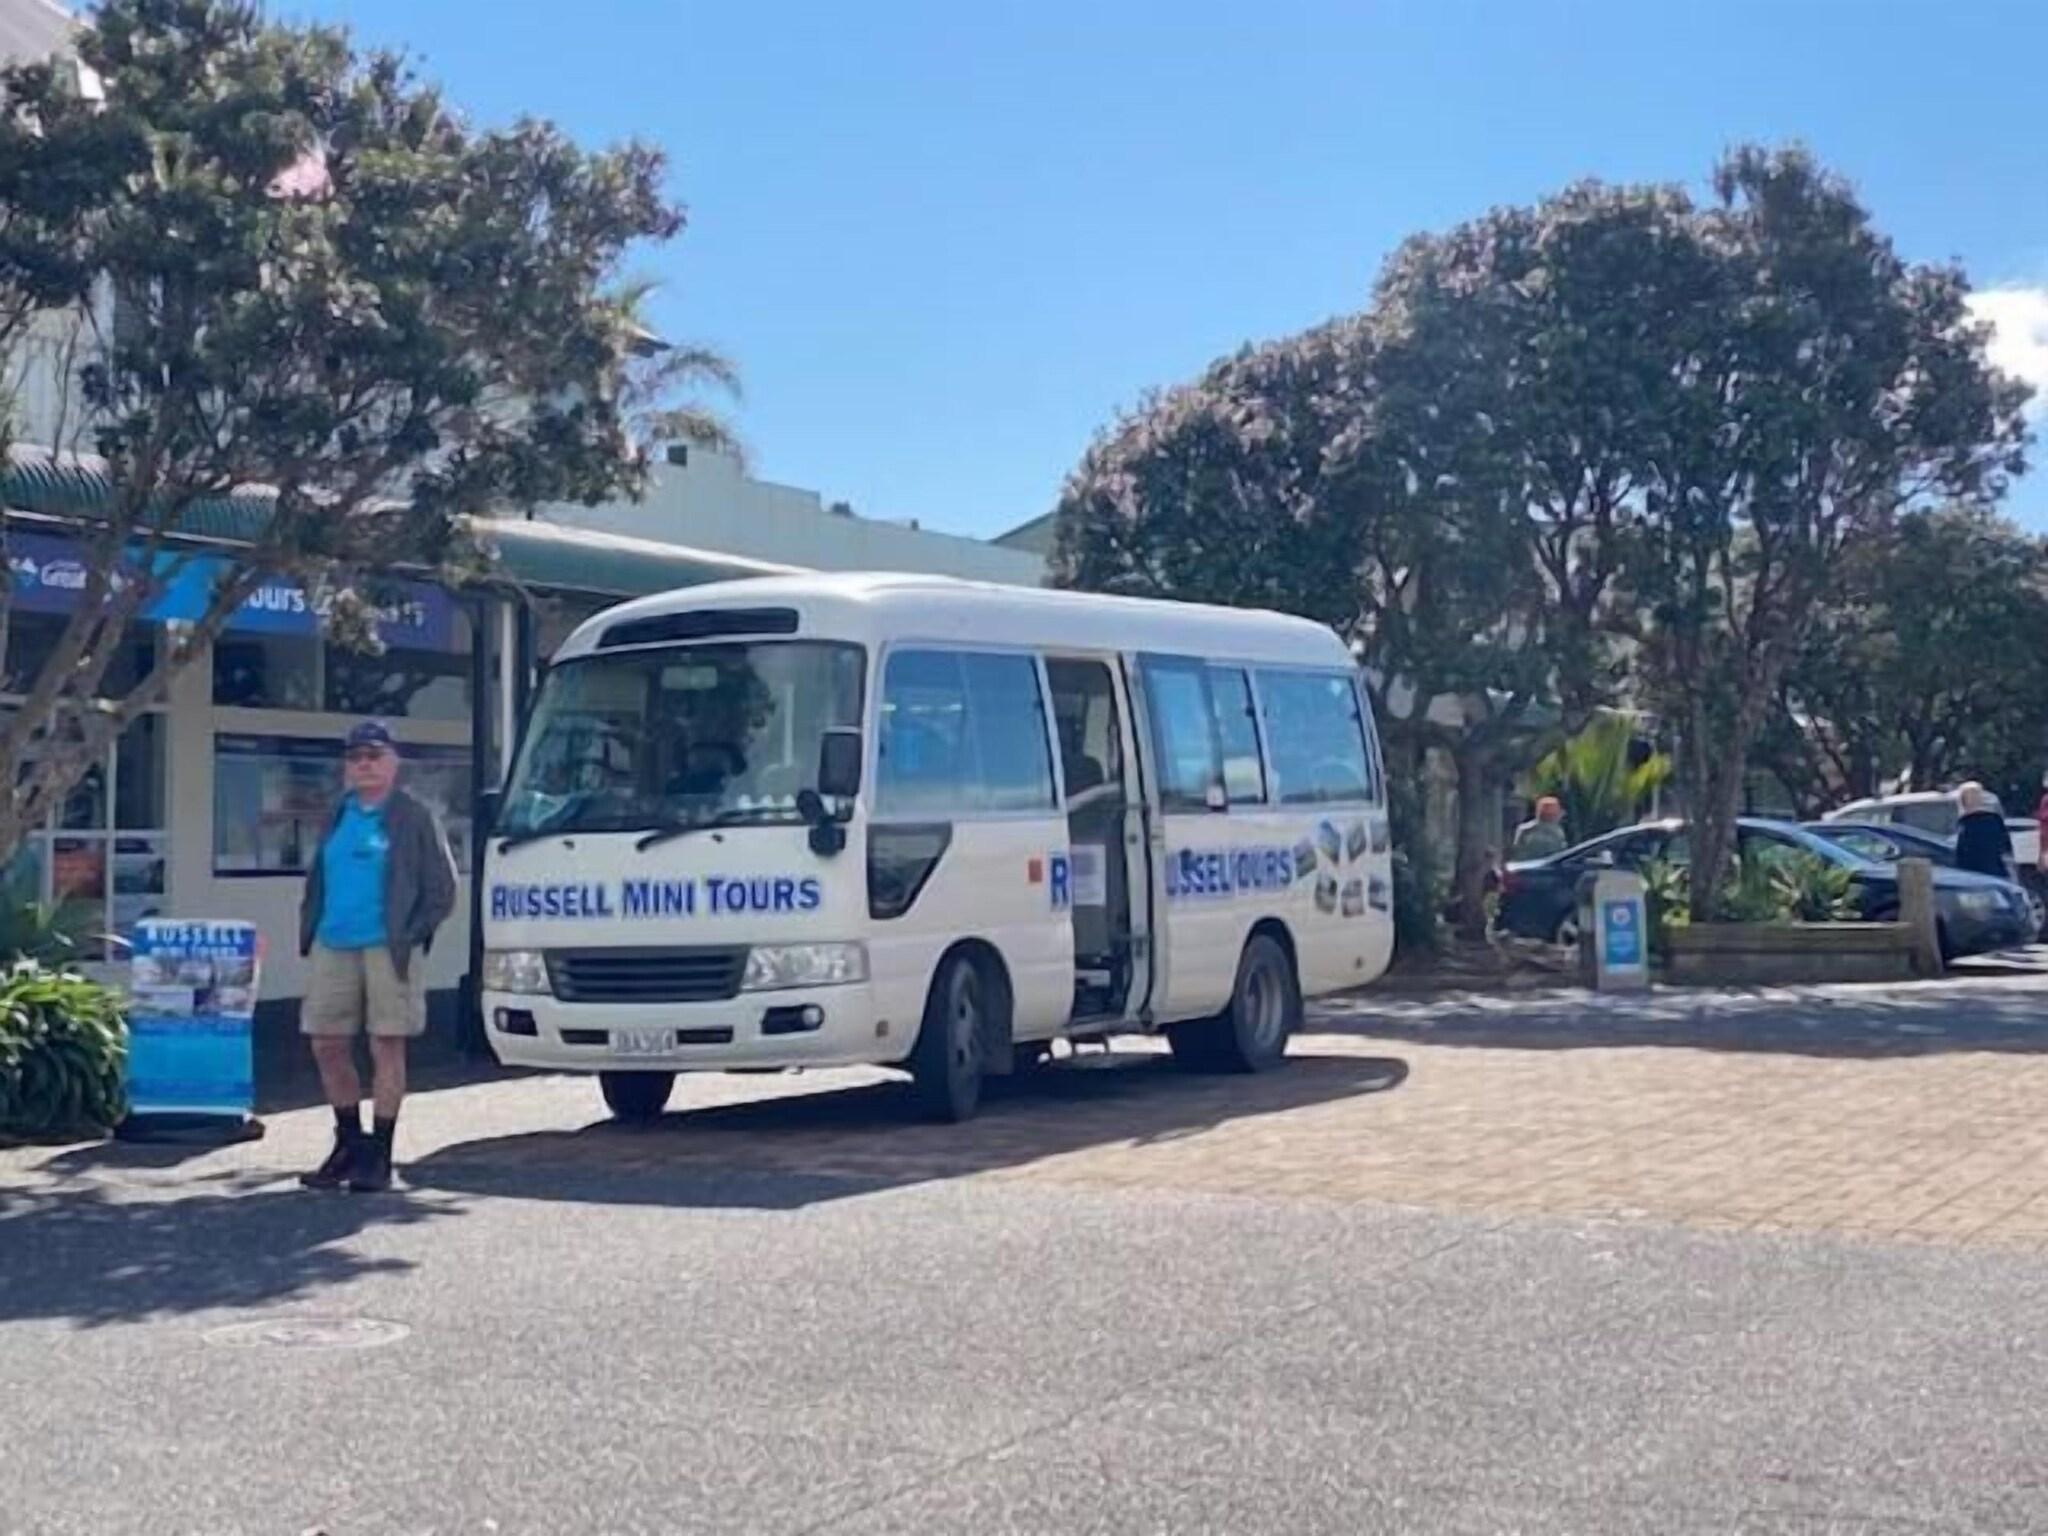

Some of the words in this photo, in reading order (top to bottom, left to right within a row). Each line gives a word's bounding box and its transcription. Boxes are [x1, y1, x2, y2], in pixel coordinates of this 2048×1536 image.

[245, 587, 305, 613] ours
[491, 884, 614, 920] RUSSELL
[622, 878, 696, 918] MINI
[706, 877, 821, 913] TOURS
